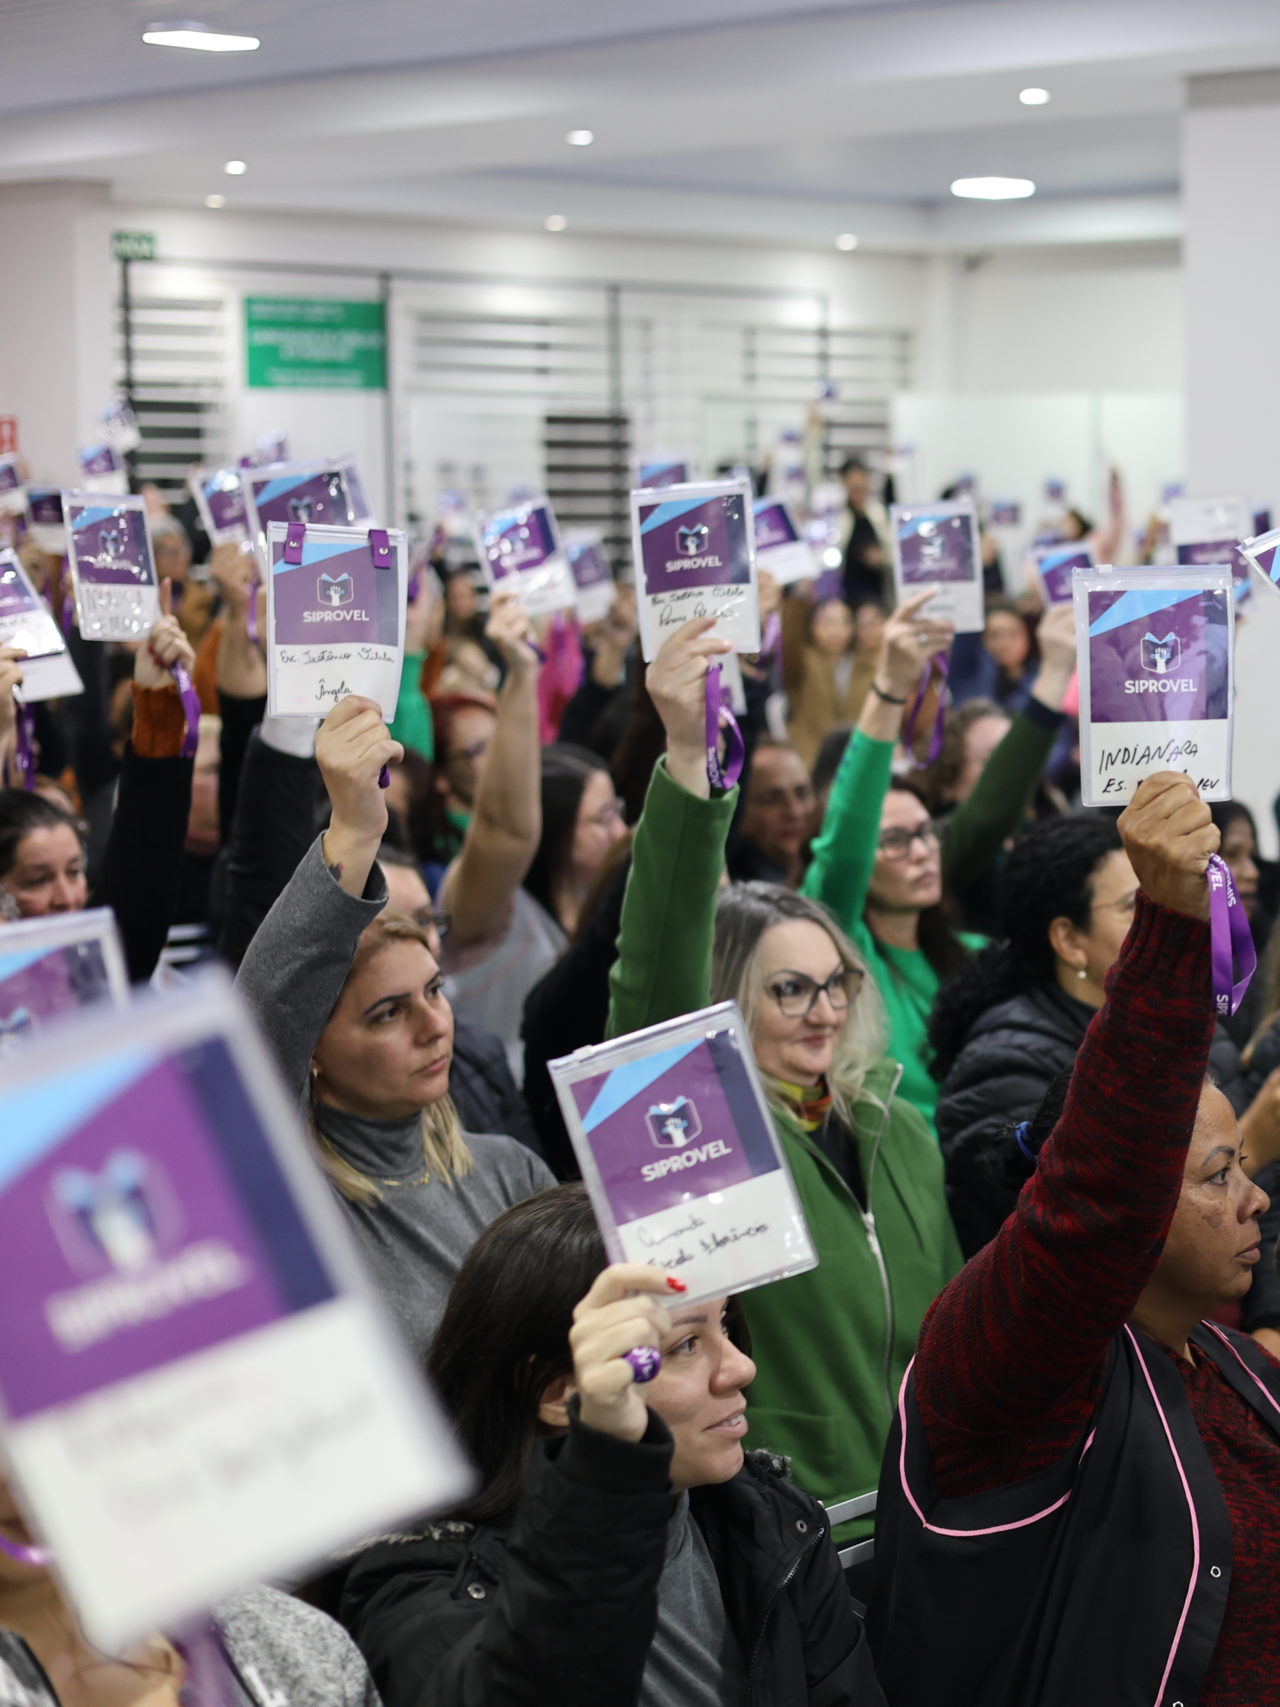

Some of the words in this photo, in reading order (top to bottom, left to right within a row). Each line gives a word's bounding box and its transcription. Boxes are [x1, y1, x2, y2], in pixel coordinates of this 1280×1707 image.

[665, 556, 723, 573] SIPROVEL
[303, 609, 370, 622] SIPROVEL
[315, 678, 352, 703] Ângela
[1124, 678, 1198, 694] SIPROVEL
[1098, 739, 1198, 775] INDIANARA
[641, 1139, 733, 1182] SIPROVEL
